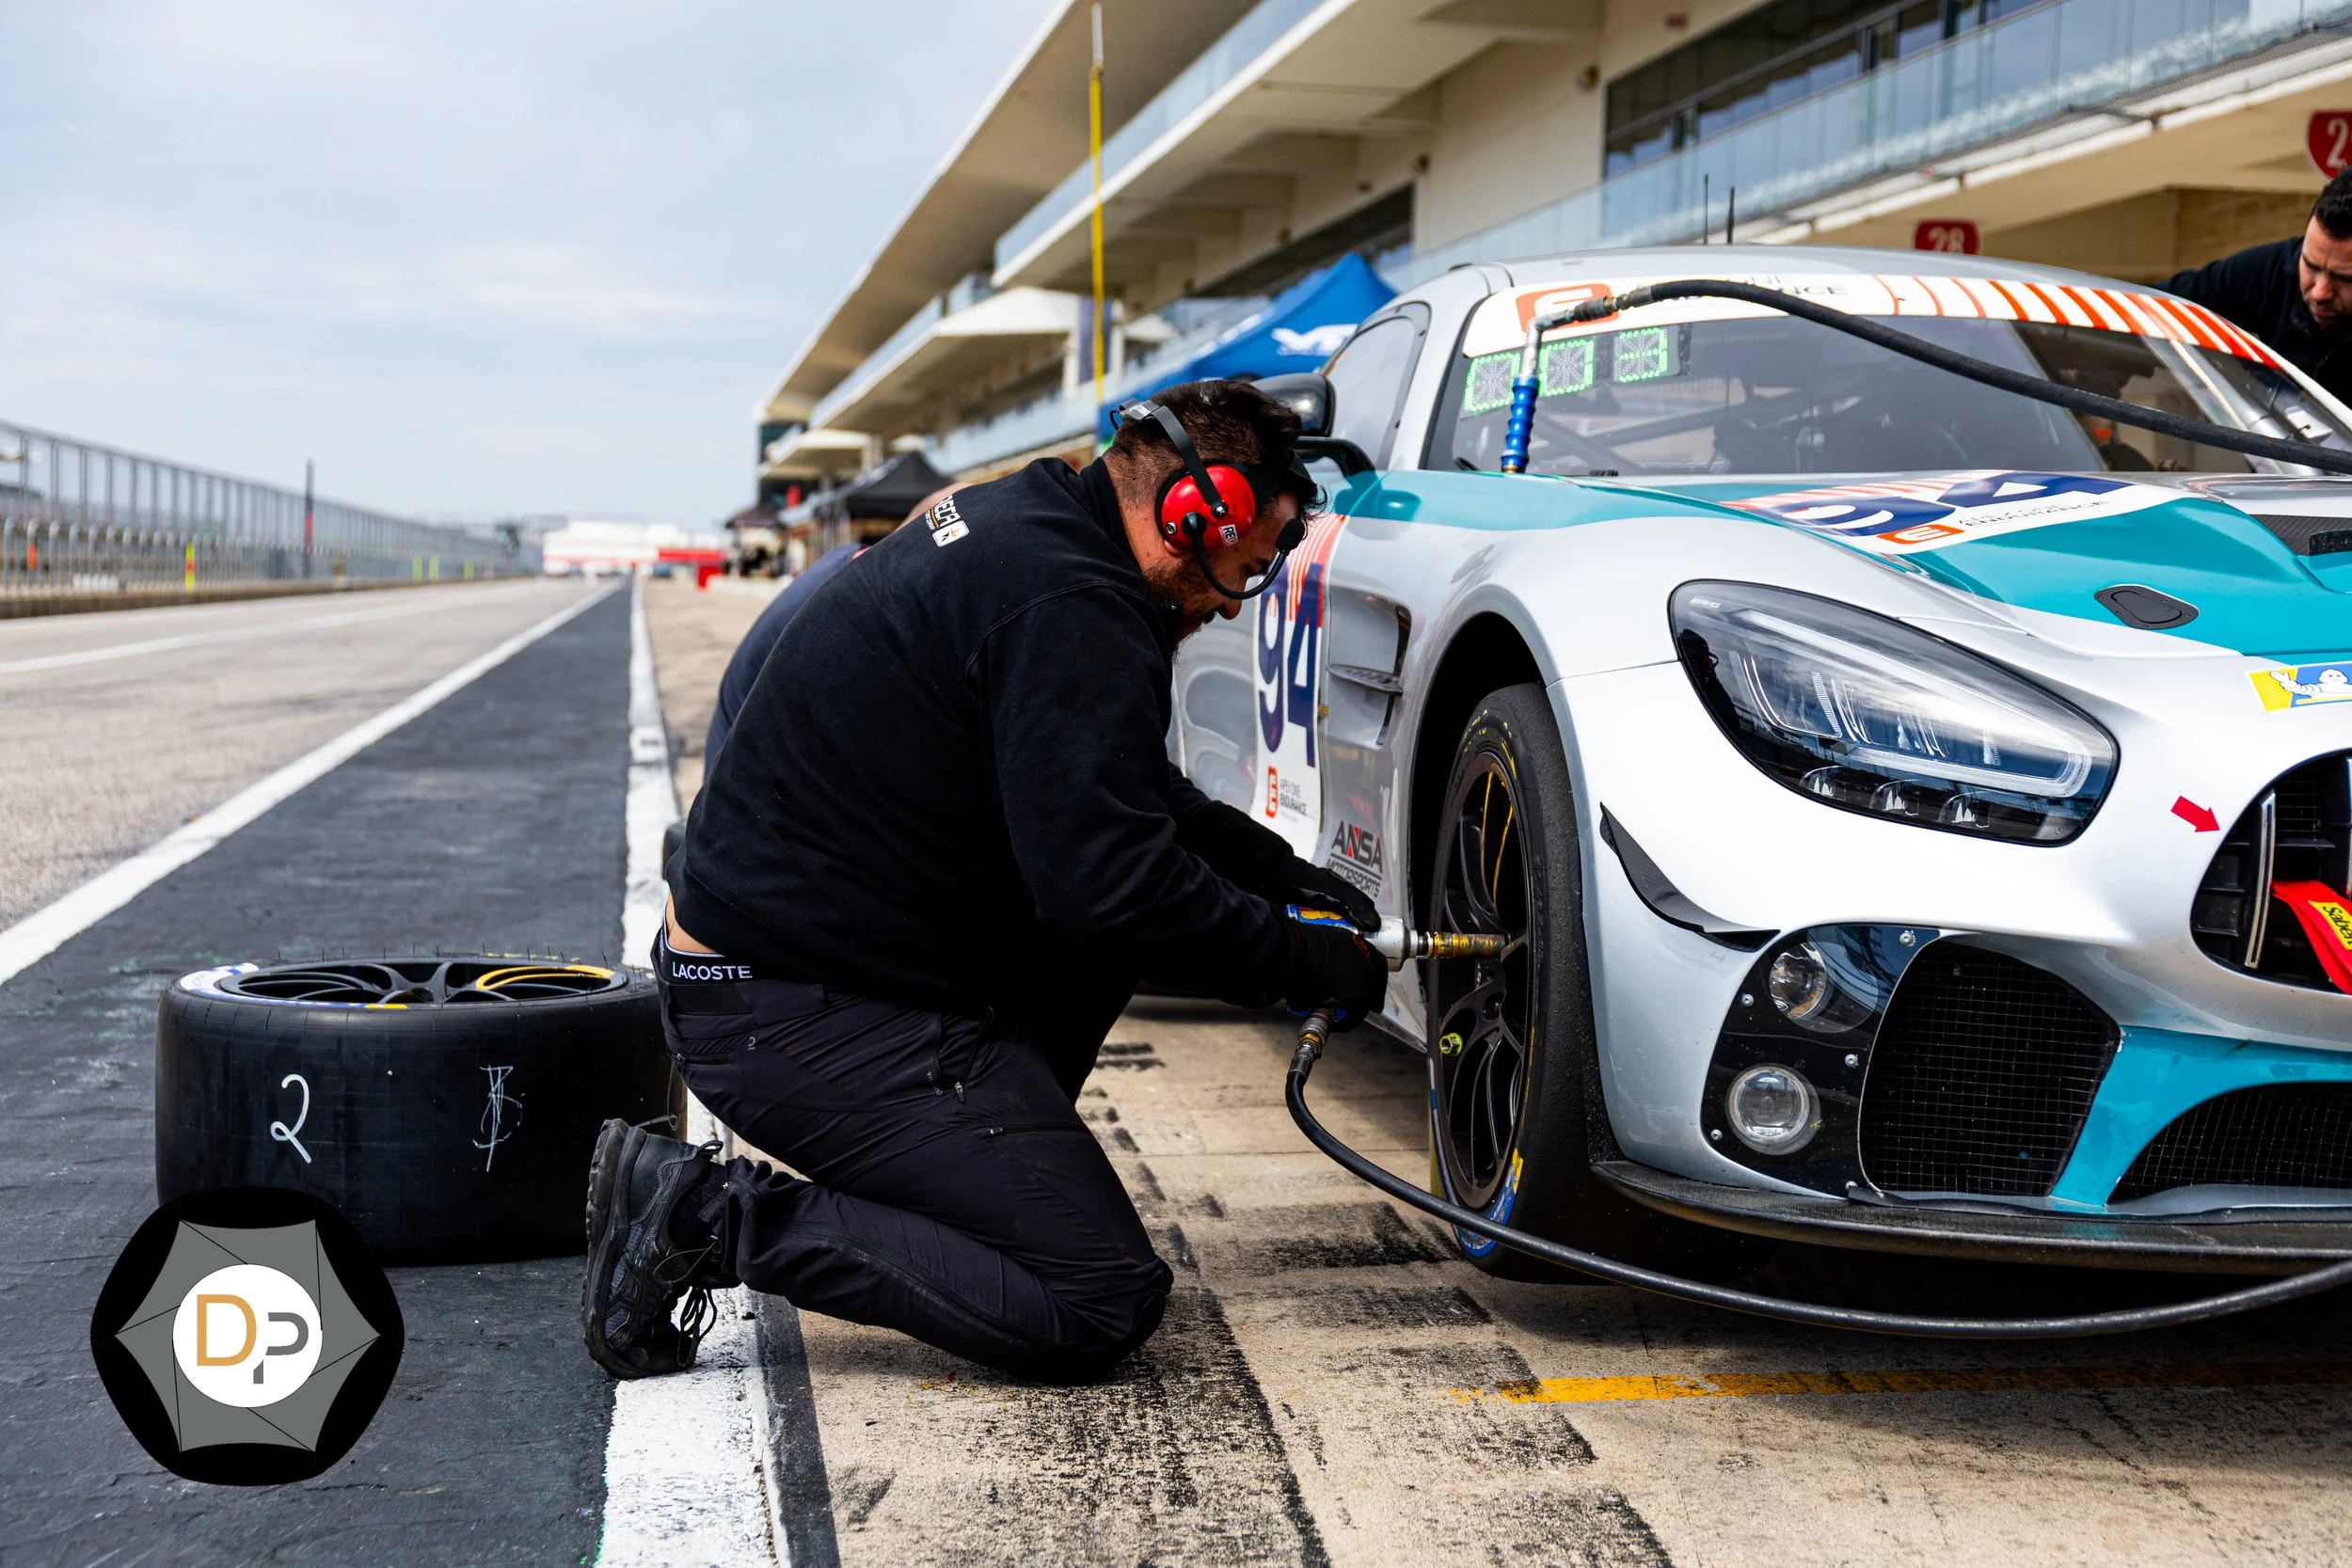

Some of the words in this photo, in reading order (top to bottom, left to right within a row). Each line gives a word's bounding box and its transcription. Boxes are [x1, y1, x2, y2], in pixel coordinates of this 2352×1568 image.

[2326, 118, 2352, 168] 2
[1258, 562, 1324, 768] 94
[1331, 820, 1384, 874] ANSA
[1326, 858, 1381, 898] MOTORSPORTS
[673, 961, 753, 980] LACOSTE
[270, 1073, 312, 1164] 2
